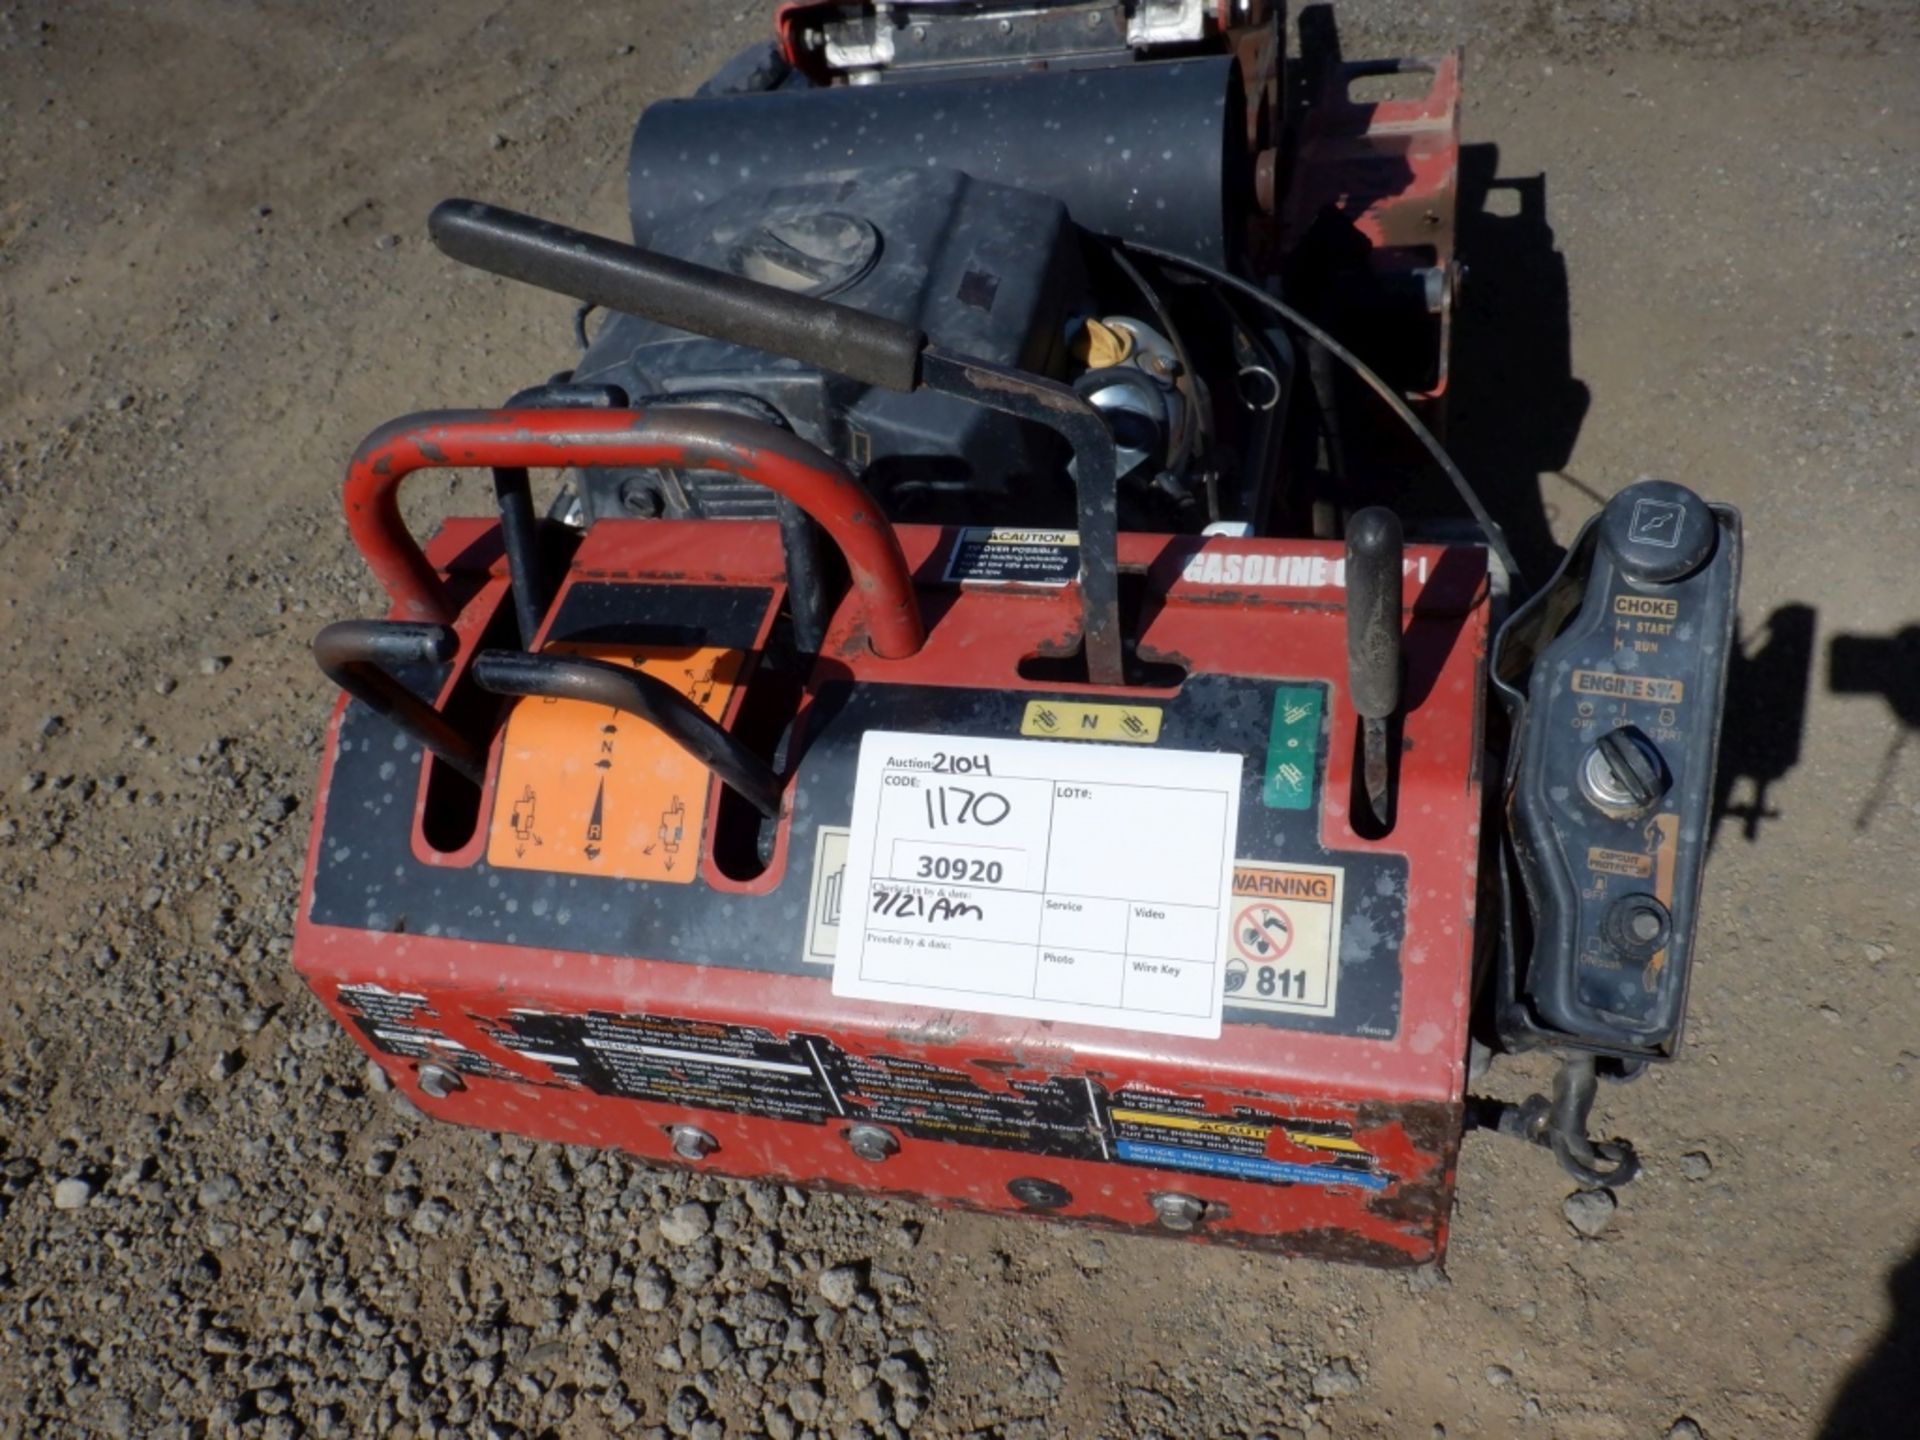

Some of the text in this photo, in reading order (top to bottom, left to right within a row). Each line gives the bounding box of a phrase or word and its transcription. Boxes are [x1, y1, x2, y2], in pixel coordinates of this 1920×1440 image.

[999, 531, 1066, 543] CAUTION
[1182, 552, 1327, 588] GASOLINE
[1616, 597, 1677, 616] CHOKE
[1636, 621, 1673, 636] START
[1633, 639, 1660, 654] RUN
[1579, 673, 1643, 697] ENGINE
[1082, 713, 1099, 728] N
[601, 740, 614, 753] N
[886, 752, 992, 777] Auction: 2104
[885, 775, 921, 788] CODE:
[926, 786, 1011, 830] 1170
[916, 855, 1003, 884] 30920
[924, 887, 935, 898] by
[937, 889, 946, 898] &
[1232, 873, 1328, 898] WARNING
[872, 890, 924, 918] 7/21
[1046, 899, 1083, 913] Service
[1135, 908, 1165, 920] Video
[867, 932, 902, 945] Proofed
[904, 935, 915, 947] by
[917, 938, 926, 948] &
[1043, 952, 1075, 965] Photo
[1132, 962, 1181, 979] Wire Key
[1256, 966, 1307, 1000] 811
